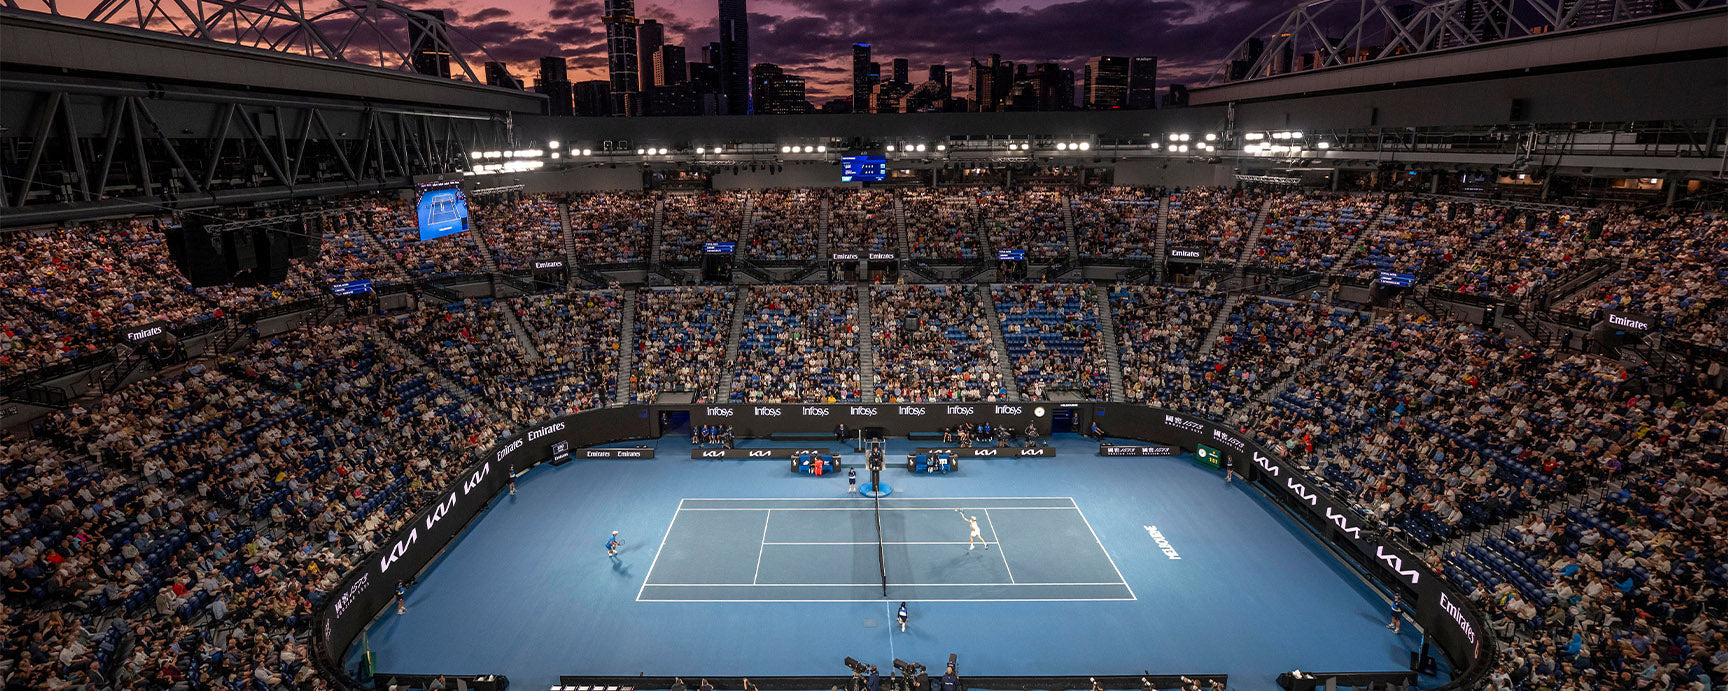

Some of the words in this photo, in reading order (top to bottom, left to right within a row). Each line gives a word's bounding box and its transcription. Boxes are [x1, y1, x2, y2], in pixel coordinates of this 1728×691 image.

[536, 261, 562, 269] Emirates
[1610, 312, 1648, 331] Emirates
[128, 325, 162, 340] Emirates
[707, 407, 733, 417] Infosys
[755, 407, 781, 417] Infosys
[803, 406, 829, 416] Infosys
[851, 406, 877, 416] Infosys
[899, 406, 925, 416] Infosys
[947, 405, 973, 415] Infosys
[995, 404, 1021, 415] Infosys
[528, 421, 566, 442] Emirates
[497, 438, 523, 462] Emirates
[1254, 451, 1279, 476] KIA
[463, 462, 490, 495] KIA
[1288, 477, 1317, 505] KIA
[426, 491, 456, 530] KIA
[1326, 507, 1360, 539] KIA
[381, 528, 417, 573] KIA
[1144, 525, 1183, 560] MELBOURNE
[1377, 546, 1419, 584] KIA
[1440, 592, 1475, 644] Emirates
